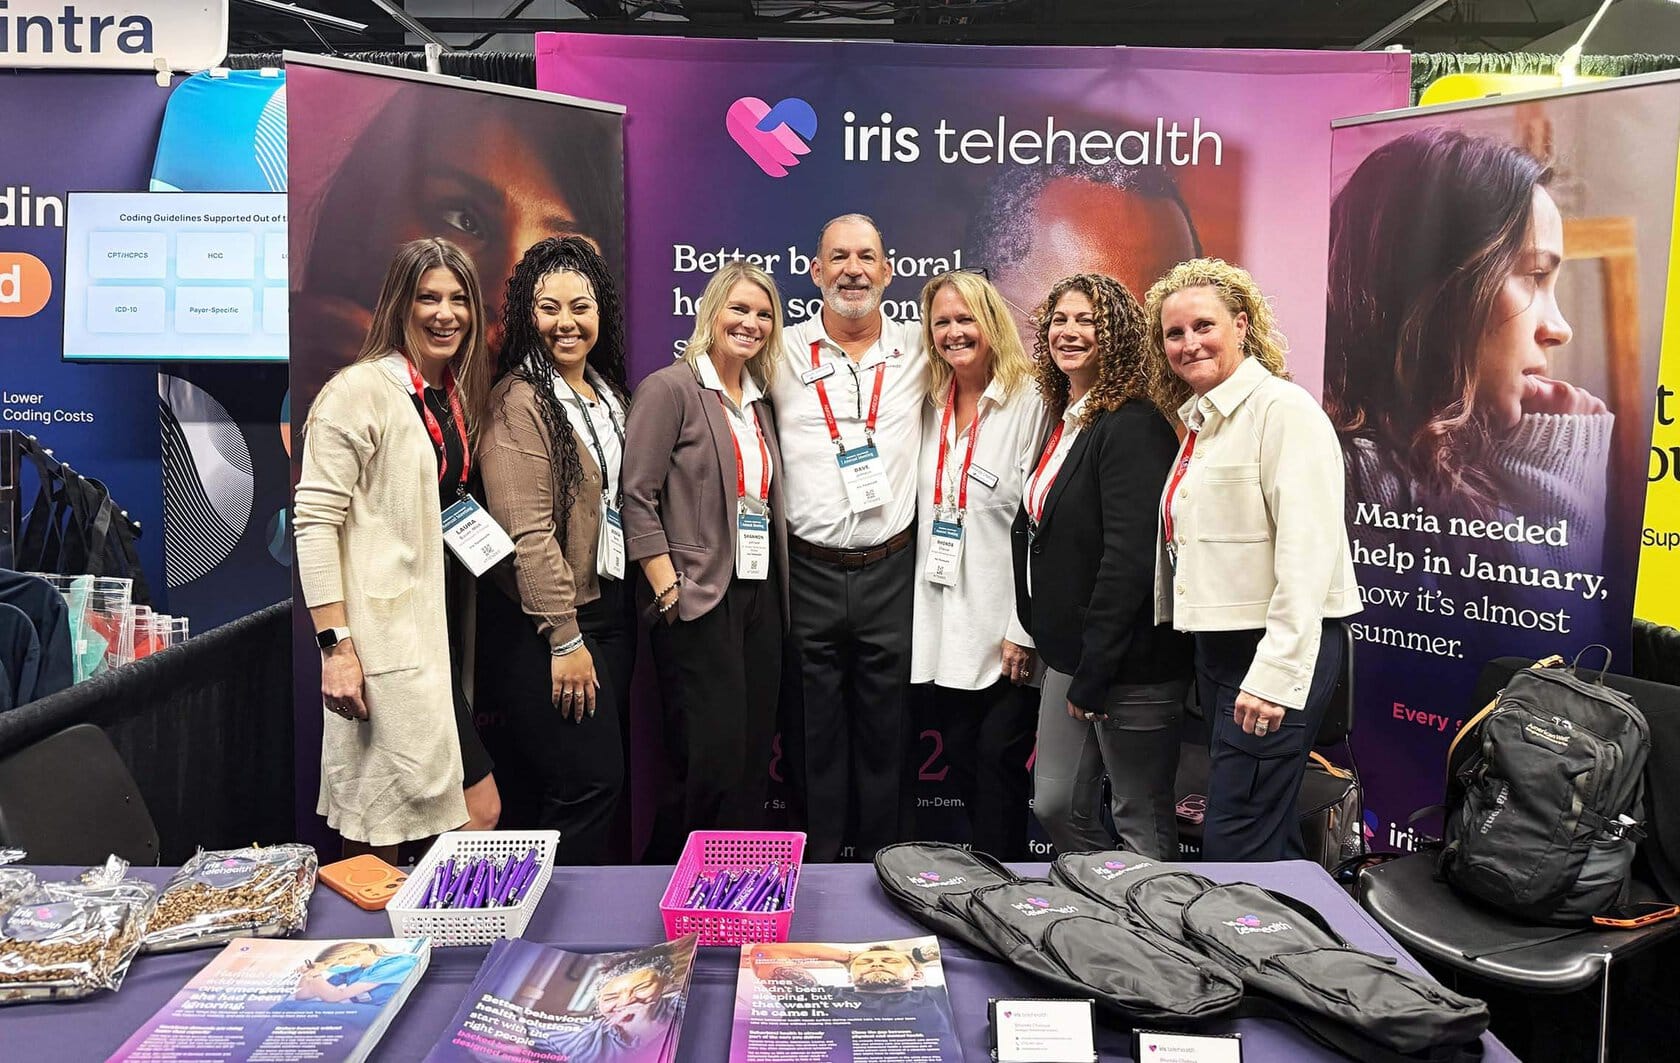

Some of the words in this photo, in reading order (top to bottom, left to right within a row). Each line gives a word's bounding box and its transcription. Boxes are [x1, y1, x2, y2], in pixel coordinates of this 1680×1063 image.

[0, 0, 153, 54] intra
[844, 111, 920, 163] iris
[935, 115, 1224, 166] telehealth
[119, 214, 152, 223] Coding
[153, 214, 202, 223] Guidelines
[203, 214, 251, 224] Supported
[252, 214, 270, 223] Out
[271, 214, 281, 223] of
[672, 244, 781, 275] Better
[788, 247, 963, 277] bioral
[3, 392, 44, 404] Lower
[3, 409, 51, 424] Coding
[53, 410, 94, 422] Costs
[456, 519, 478, 535] LAURA
[1353, 502, 1441, 534] Maria
[1448, 516, 1569, 547] needed
[1352, 539, 1415, 574] help
[1423, 548, 1452, 575] in
[1460, 553, 1608, 600] January,
[1355, 584, 1410, 608] now
[1416, 586, 1455, 616] it’s
[1463, 596, 1571, 634] almost
[1350, 621, 1464, 659] summer.
[1392, 702, 1450, 732] Every
[1029, 840, 1053, 855] for
[1389, 822, 1420, 852] iri
[811, 993, 834, 1001] but
[832, 1000, 862, 1010] why
[470, 1011, 499, 1028] start
[501, 1018, 527, 1035] with
[529, 1028, 550, 1040] the
[475, 1002, 517, 1021] health
[751, 1008, 769, 1016] he
[771, 1009, 809, 1017] came
[463, 1020, 494, 1037] right
[495, 1029, 536, 1047] people
